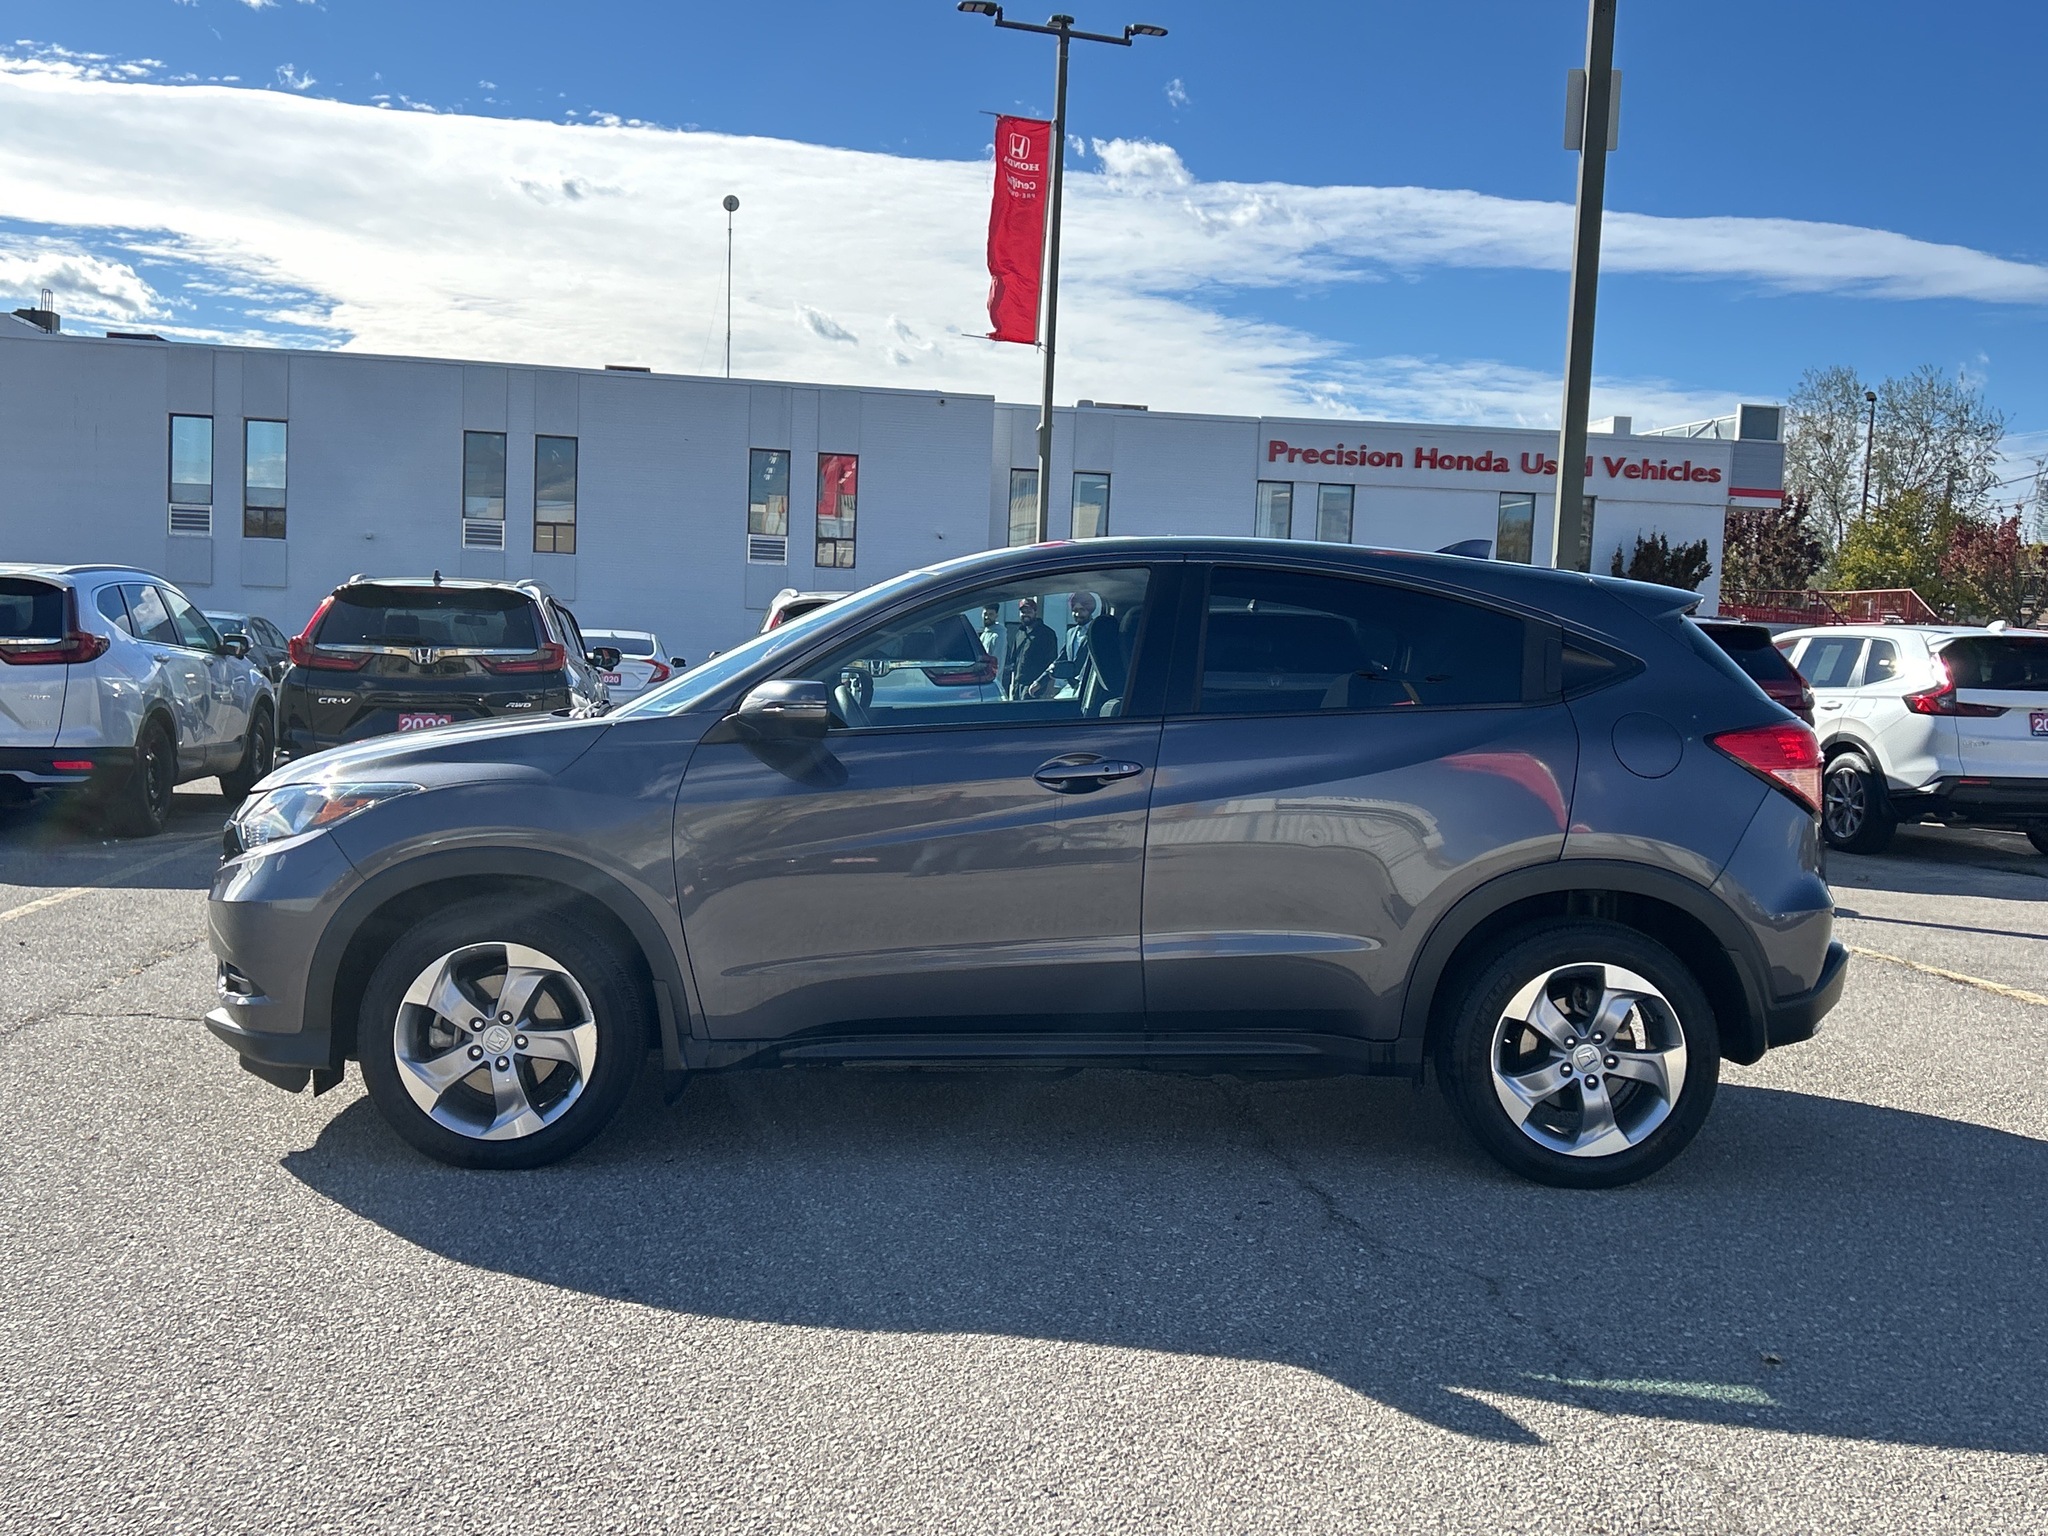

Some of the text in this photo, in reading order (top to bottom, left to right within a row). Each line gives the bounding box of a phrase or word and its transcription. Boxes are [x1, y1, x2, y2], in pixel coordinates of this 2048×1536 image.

[1268, 440, 1721, 483] Precision Honda Usd Vehicles
[602, 675, 620, 683] 020
